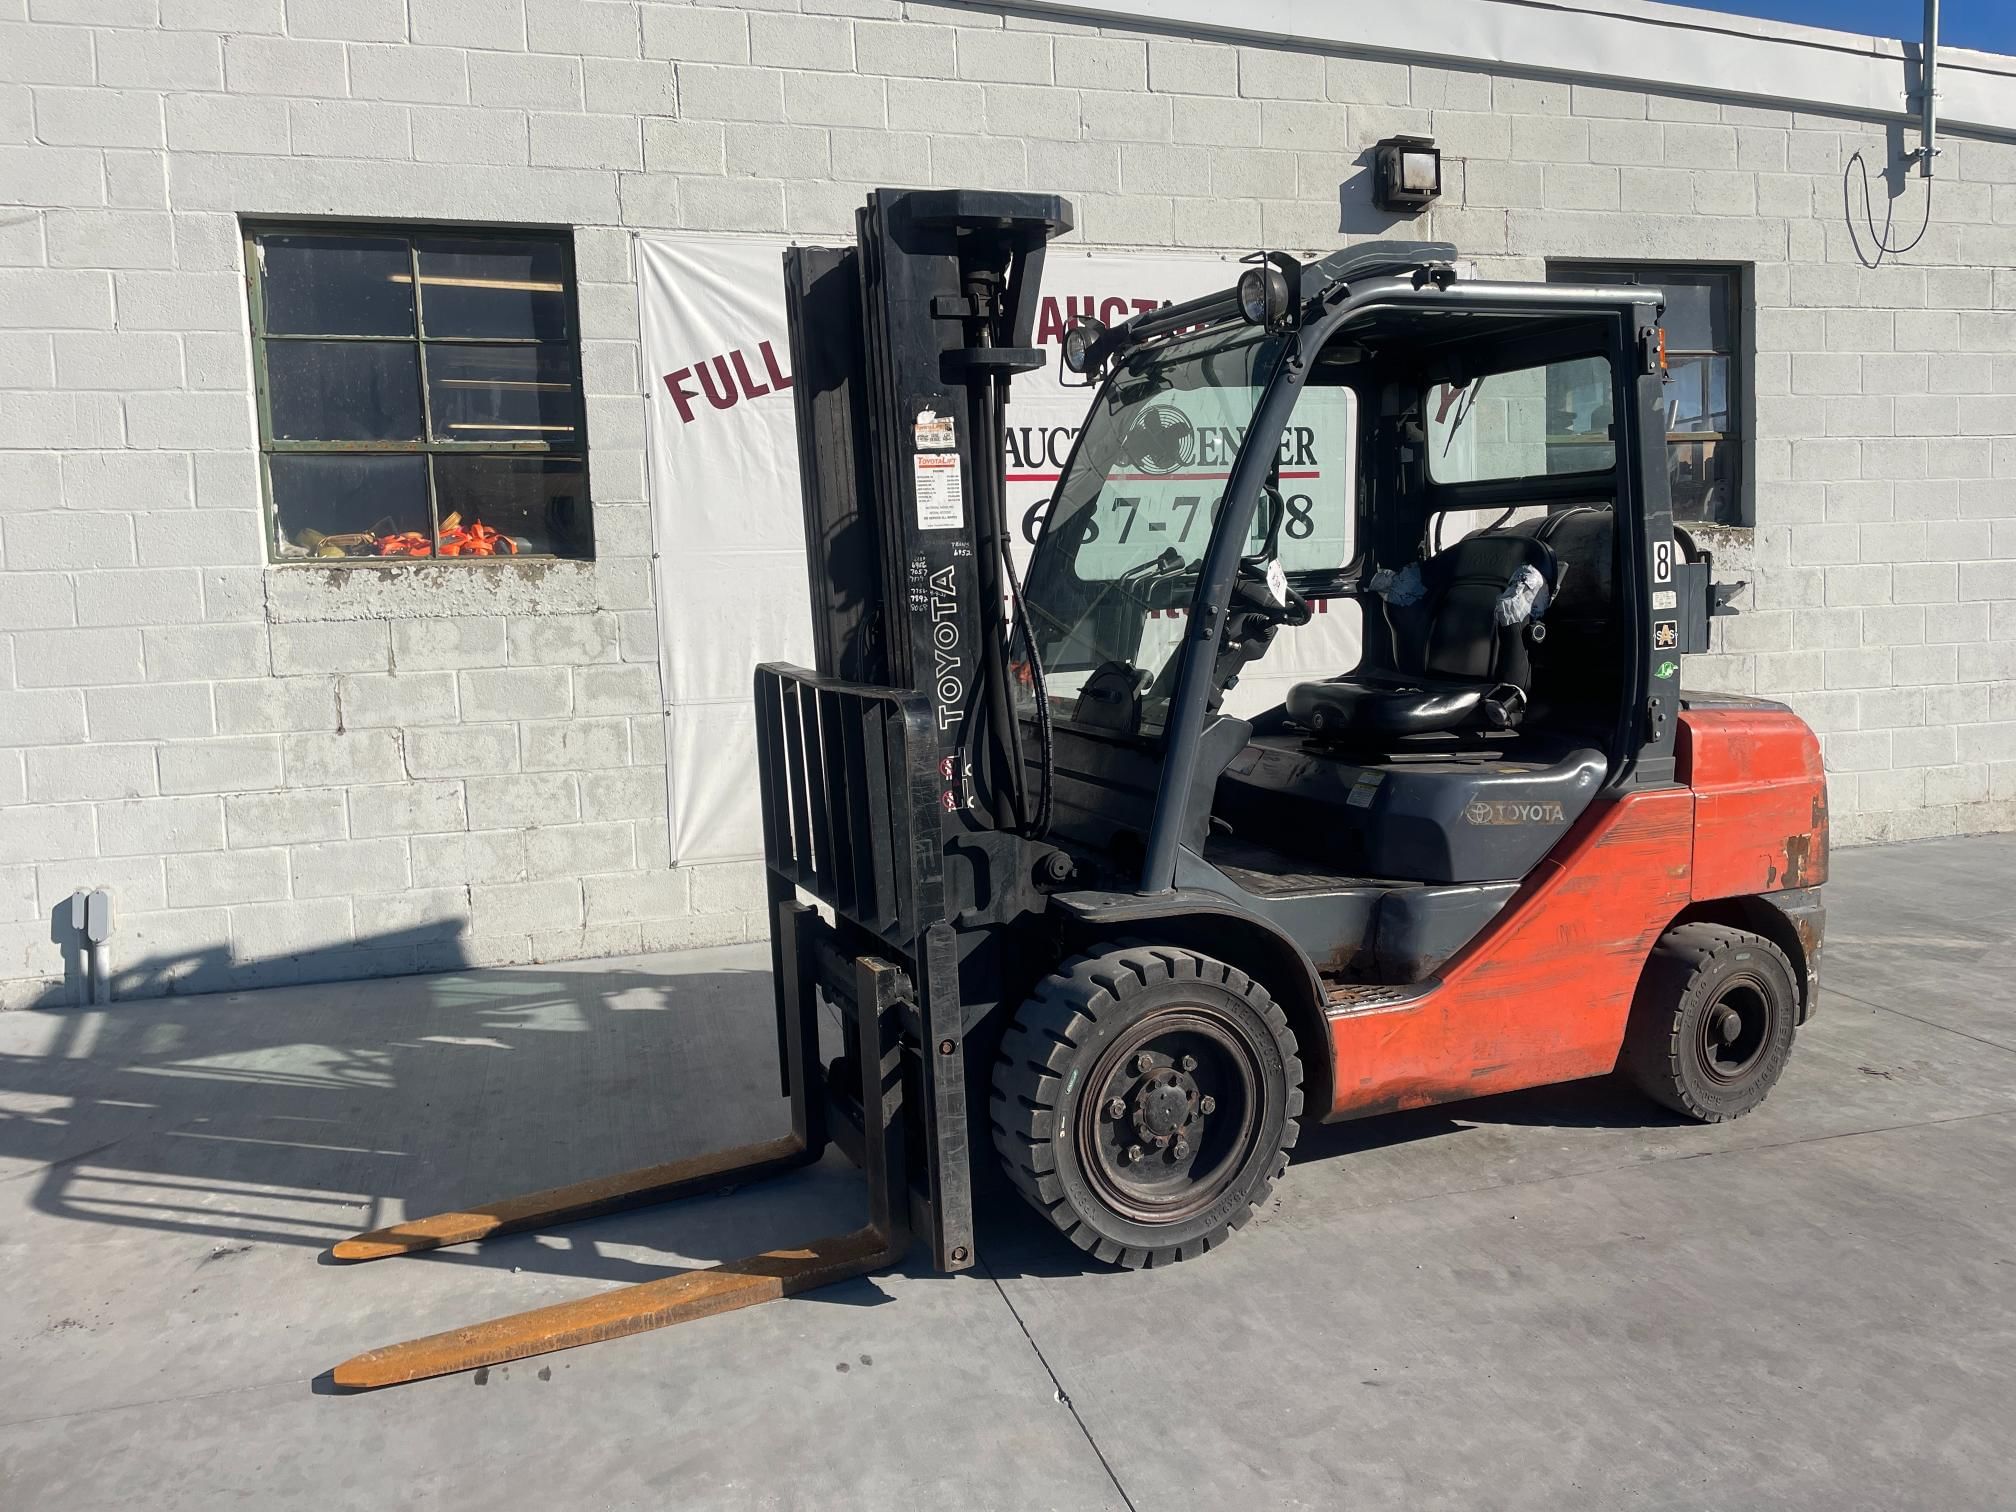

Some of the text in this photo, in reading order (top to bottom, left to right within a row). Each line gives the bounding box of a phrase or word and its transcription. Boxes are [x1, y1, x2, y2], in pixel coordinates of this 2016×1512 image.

[663, 340, 793, 424] FULL
[1657, 543, 1669, 580] 8
[930, 565, 964, 730] TOYOTA
[1496, 805, 1564, 821] TOYOTA
